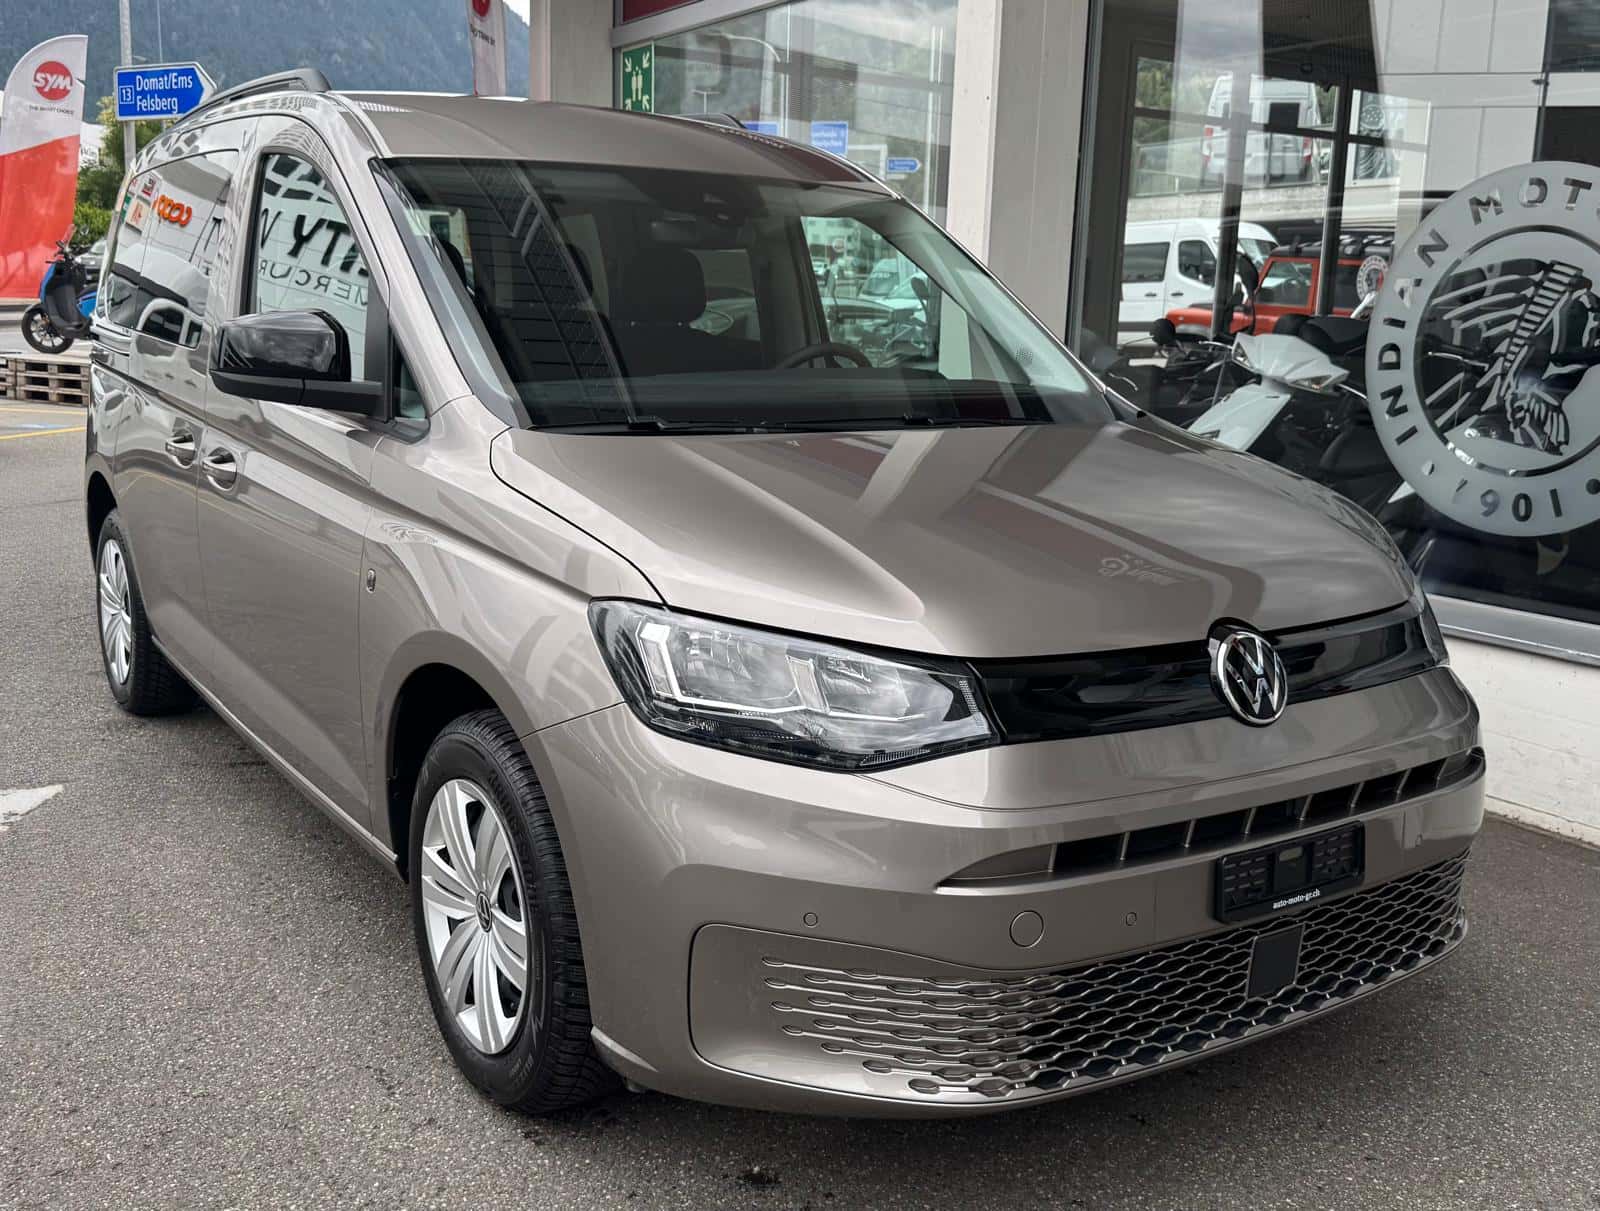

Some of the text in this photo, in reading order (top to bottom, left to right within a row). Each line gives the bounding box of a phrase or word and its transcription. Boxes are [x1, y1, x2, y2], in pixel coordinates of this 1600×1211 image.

[32, 72, 73, 92] SYM
[136, 72, 193, 91] Domat/Ems
[121, 89, 132, 103] 13
[136, 95, 178, 114] Felsberg
[1377, 176, 1600, 446] INDIAN MOT
